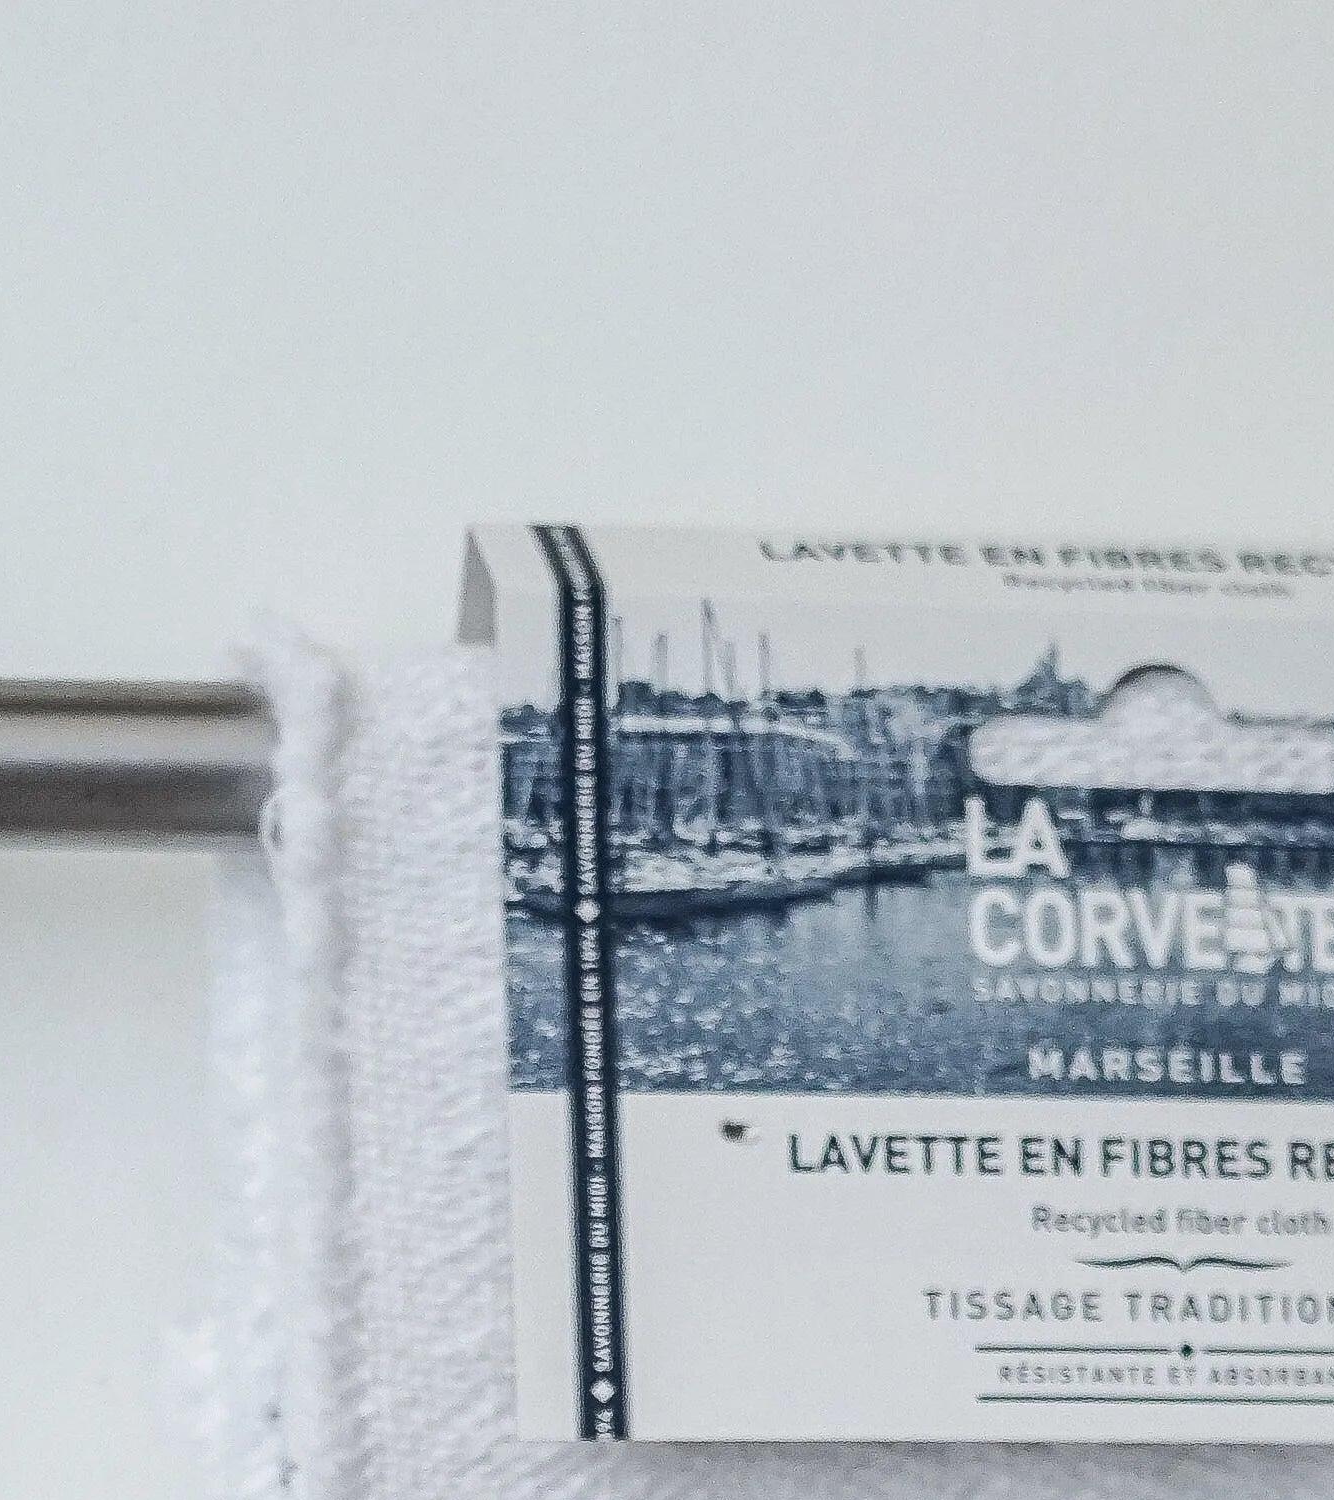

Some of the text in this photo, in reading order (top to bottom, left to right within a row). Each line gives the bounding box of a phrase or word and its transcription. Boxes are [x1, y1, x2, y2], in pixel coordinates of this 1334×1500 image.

[964, 798, 1069, 878] LA
[972, 977, 1201, 1007] SAVONNERIE
[1028, 1045, 1309, 1086] MARSEILLE
[787, 1133, 1003, 1175] LAVETTE
[1019, 1136, 1082, 1176] EN
[1101, 1137, 1272, 1180] FIBRES
[1031, 1205, 1334, 1238] Recycled fiber cloth
[922, 1288, 1103, 1322] TISSAGE
[1166, 1366, 1197, 1386] ET
